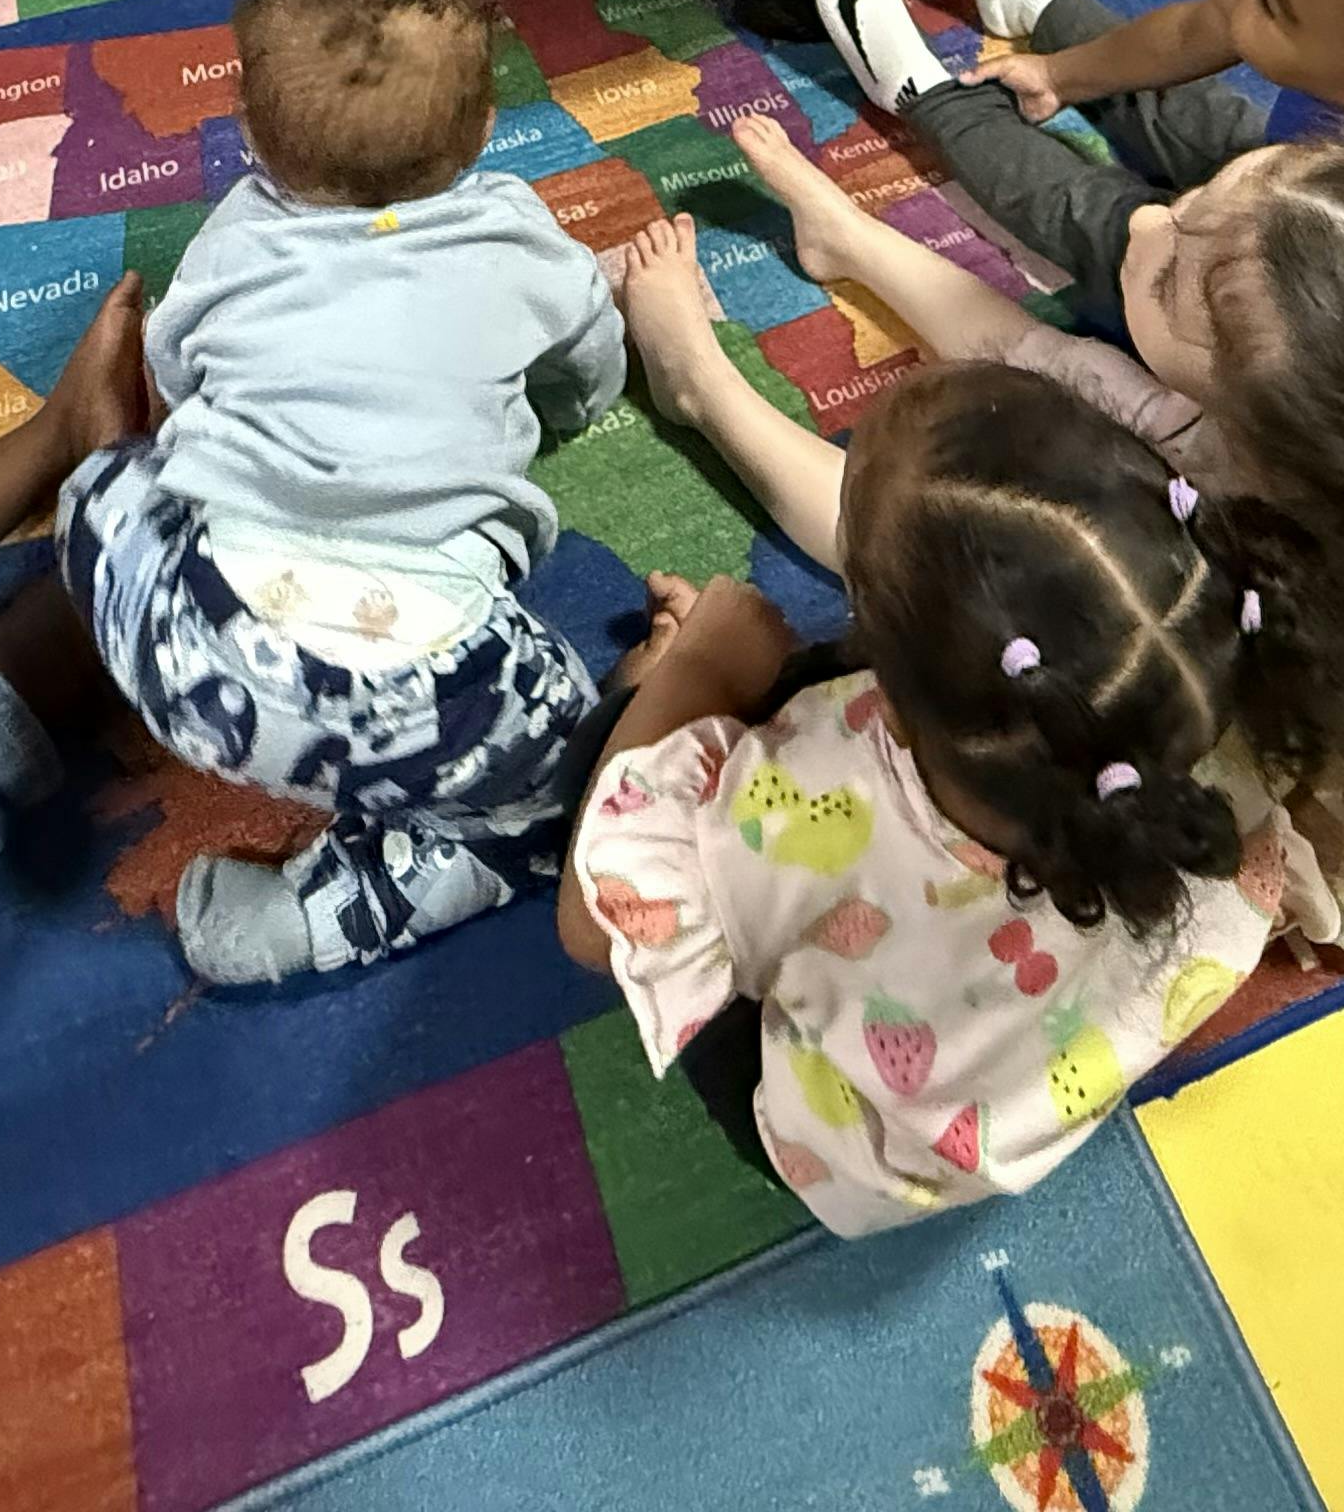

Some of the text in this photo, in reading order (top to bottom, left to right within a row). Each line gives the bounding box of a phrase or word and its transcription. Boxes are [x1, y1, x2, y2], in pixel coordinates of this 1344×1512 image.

[593, 78, 657, 106] Iowa
[708, 92, 790, 129] Illinois
[100, 160, 179, 193] Idaho
[659, 159, 750, 192] Missouri
[282, 1189, 444, 1404] Ss
